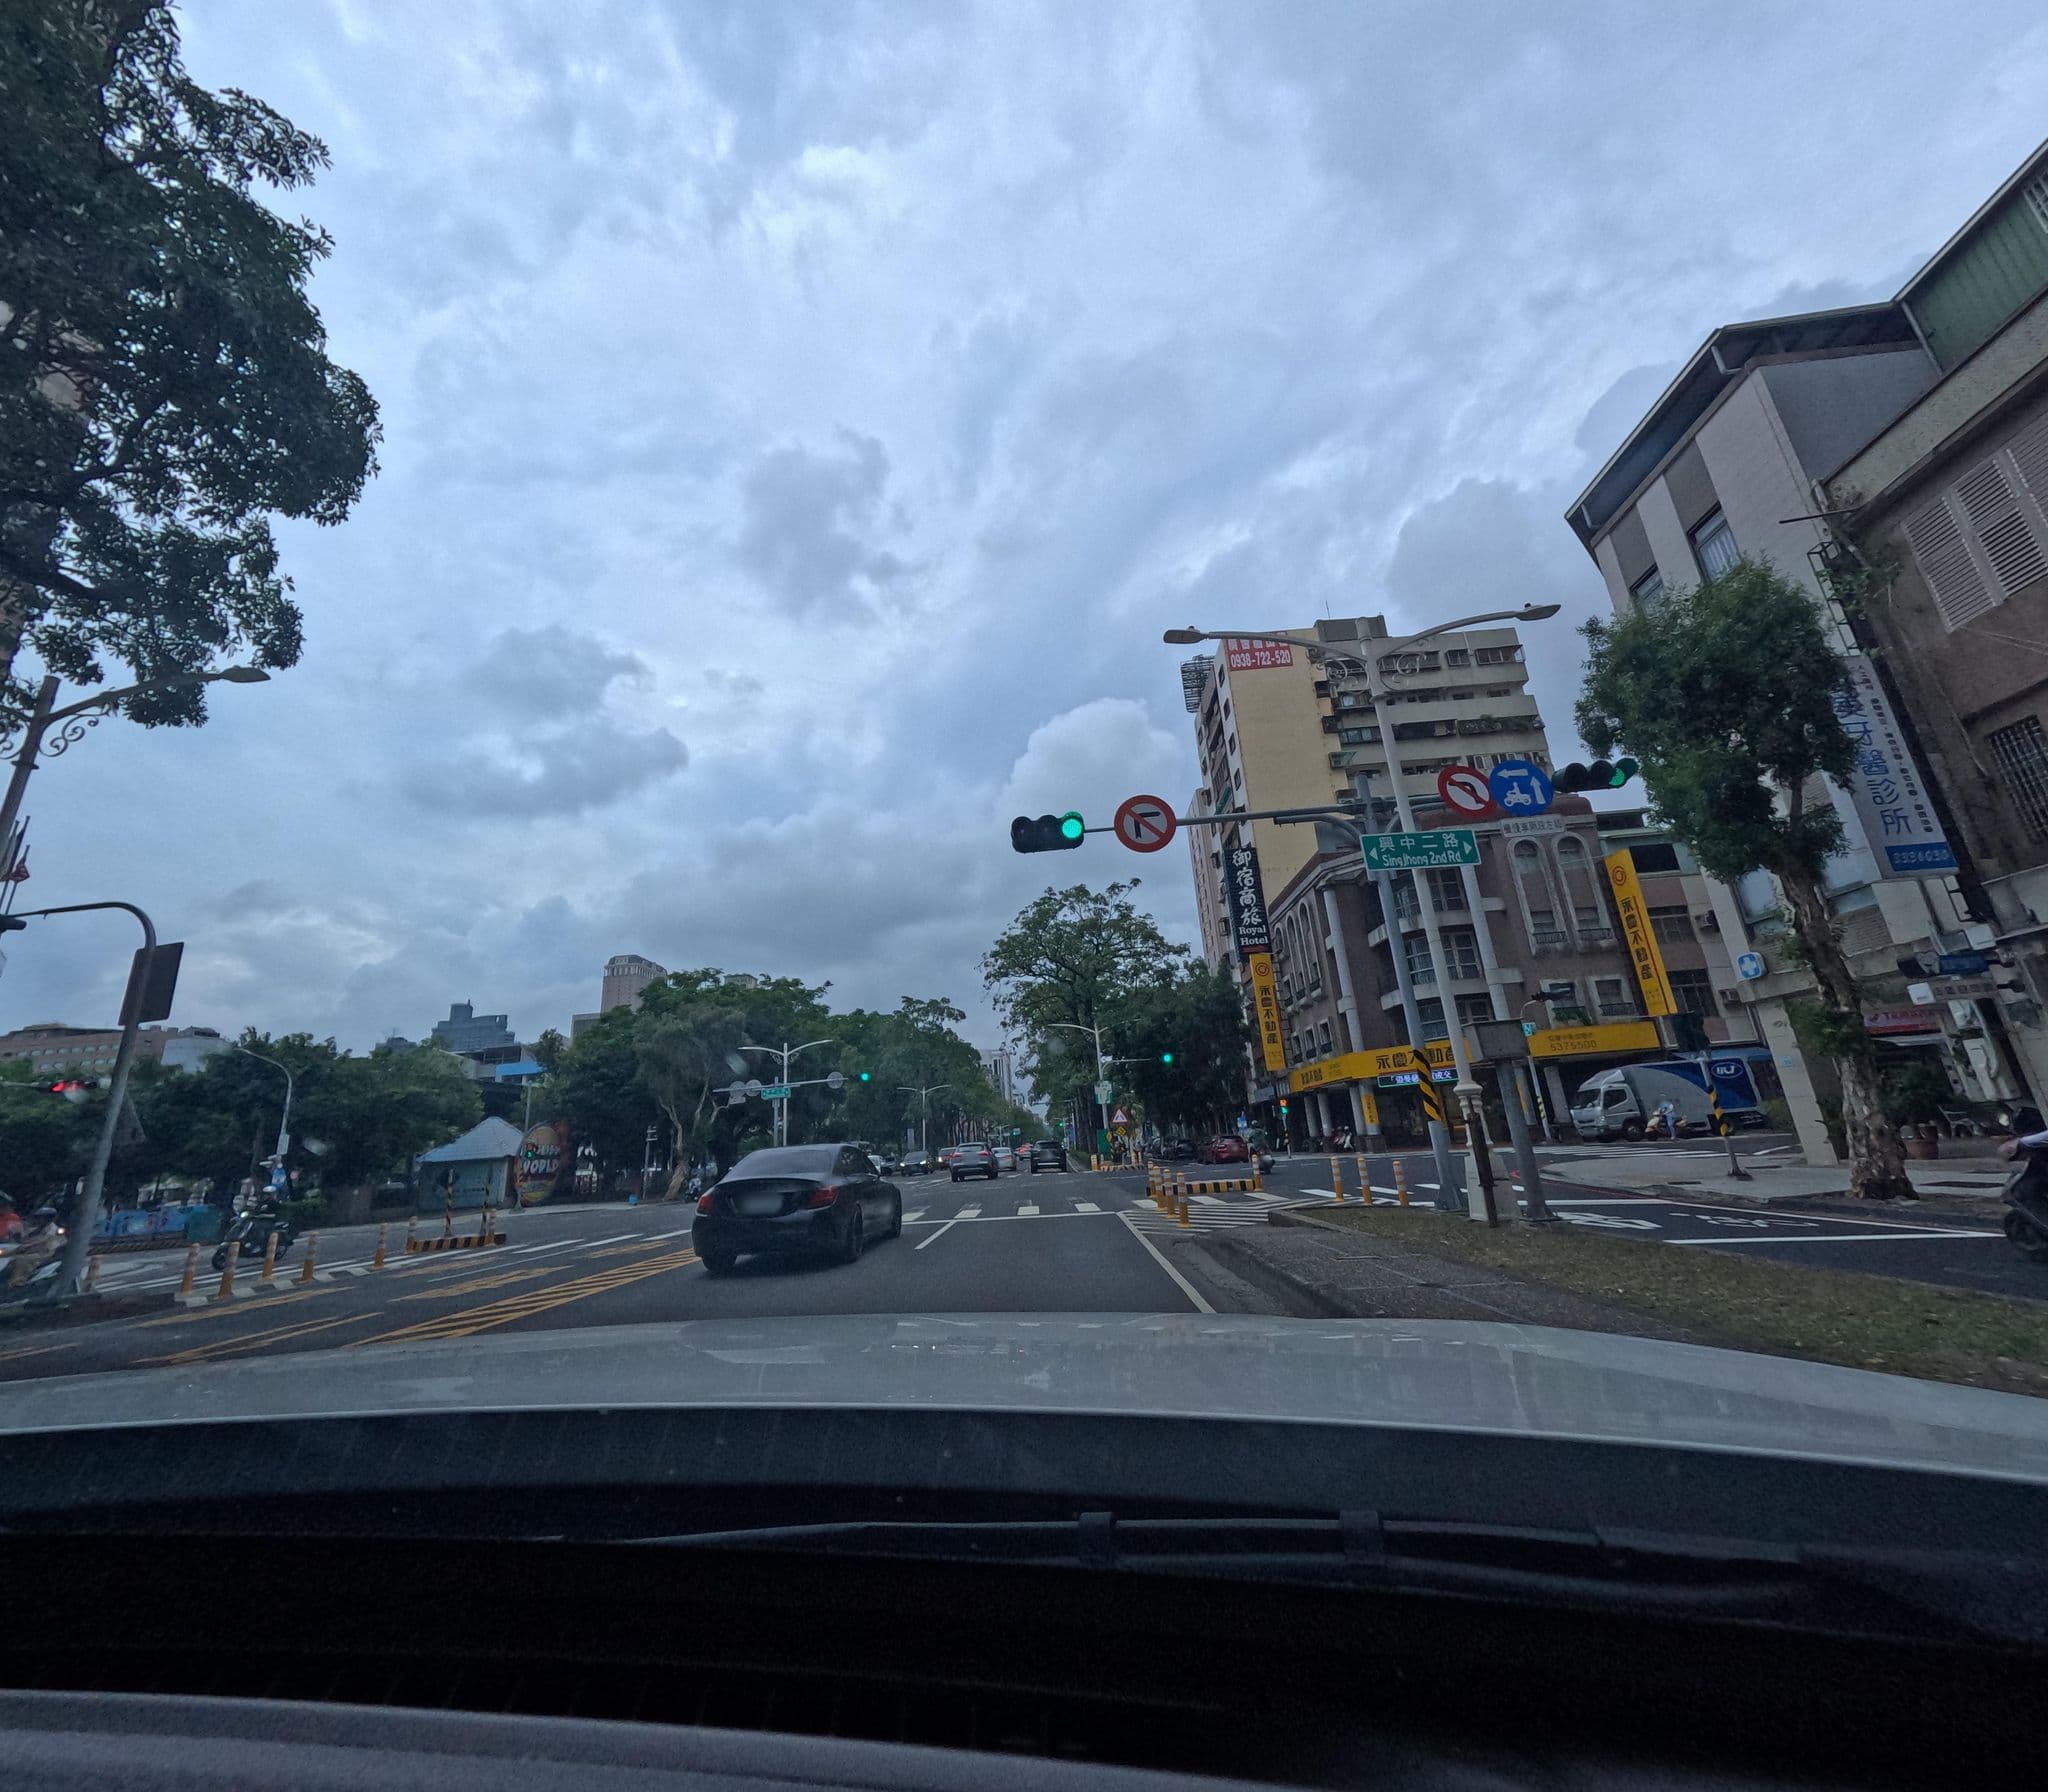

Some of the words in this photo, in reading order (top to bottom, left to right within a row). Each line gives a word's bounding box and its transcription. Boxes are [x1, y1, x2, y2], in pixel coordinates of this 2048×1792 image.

[1379, 833, 1458, 851] 興中二路
[1429, 851, 1448, 864] 2nd
[1232, 849, 1262, 926] 御宿商旅
[1239, 925, 1267, 936] Royal
[1240, 936, 1269, 946] Hotel
